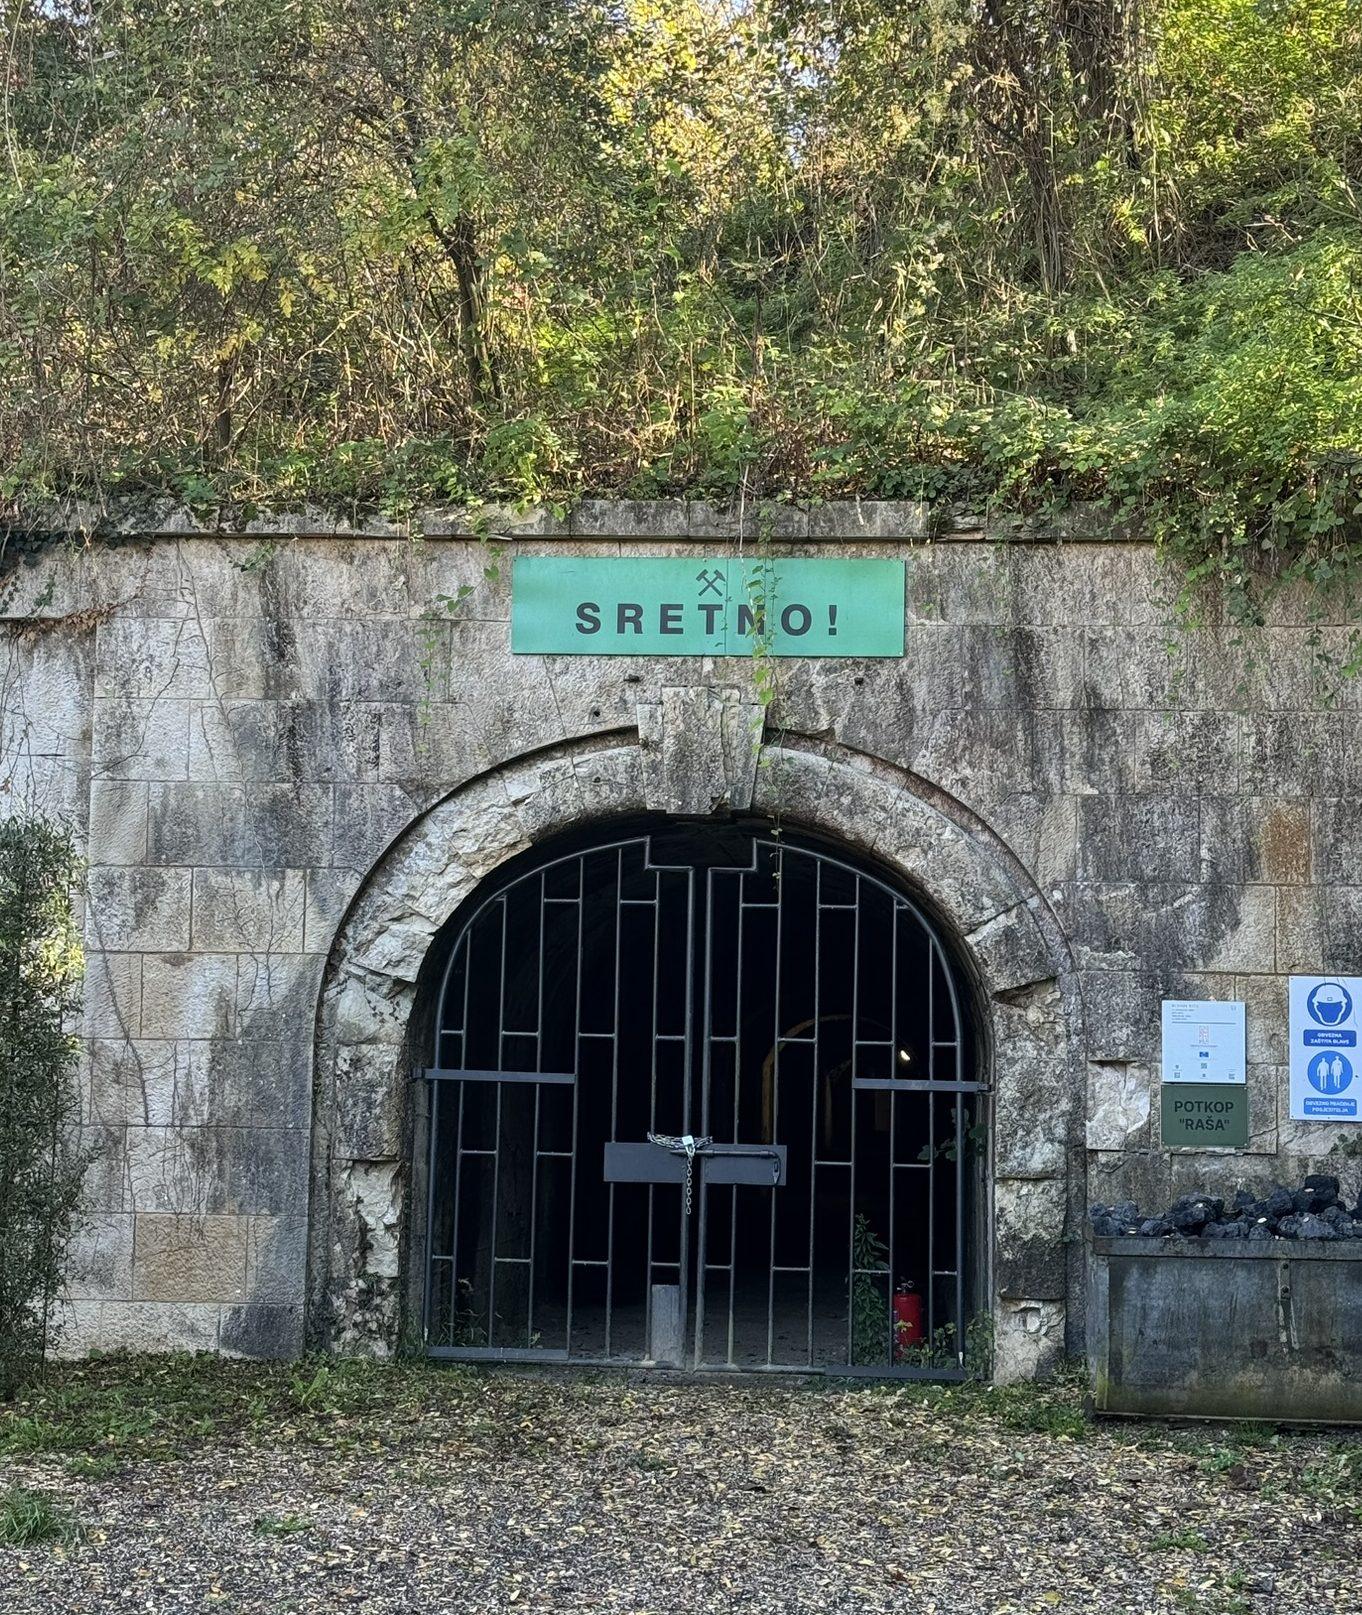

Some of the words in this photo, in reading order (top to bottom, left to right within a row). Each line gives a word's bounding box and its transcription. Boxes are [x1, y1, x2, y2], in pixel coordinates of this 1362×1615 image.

[575, 602, 838, 636] SRETNO!
[1174, 1101, 1234, 1113] POTKOP
[1179, 1115, 1230, 1131] "RAŠA"
